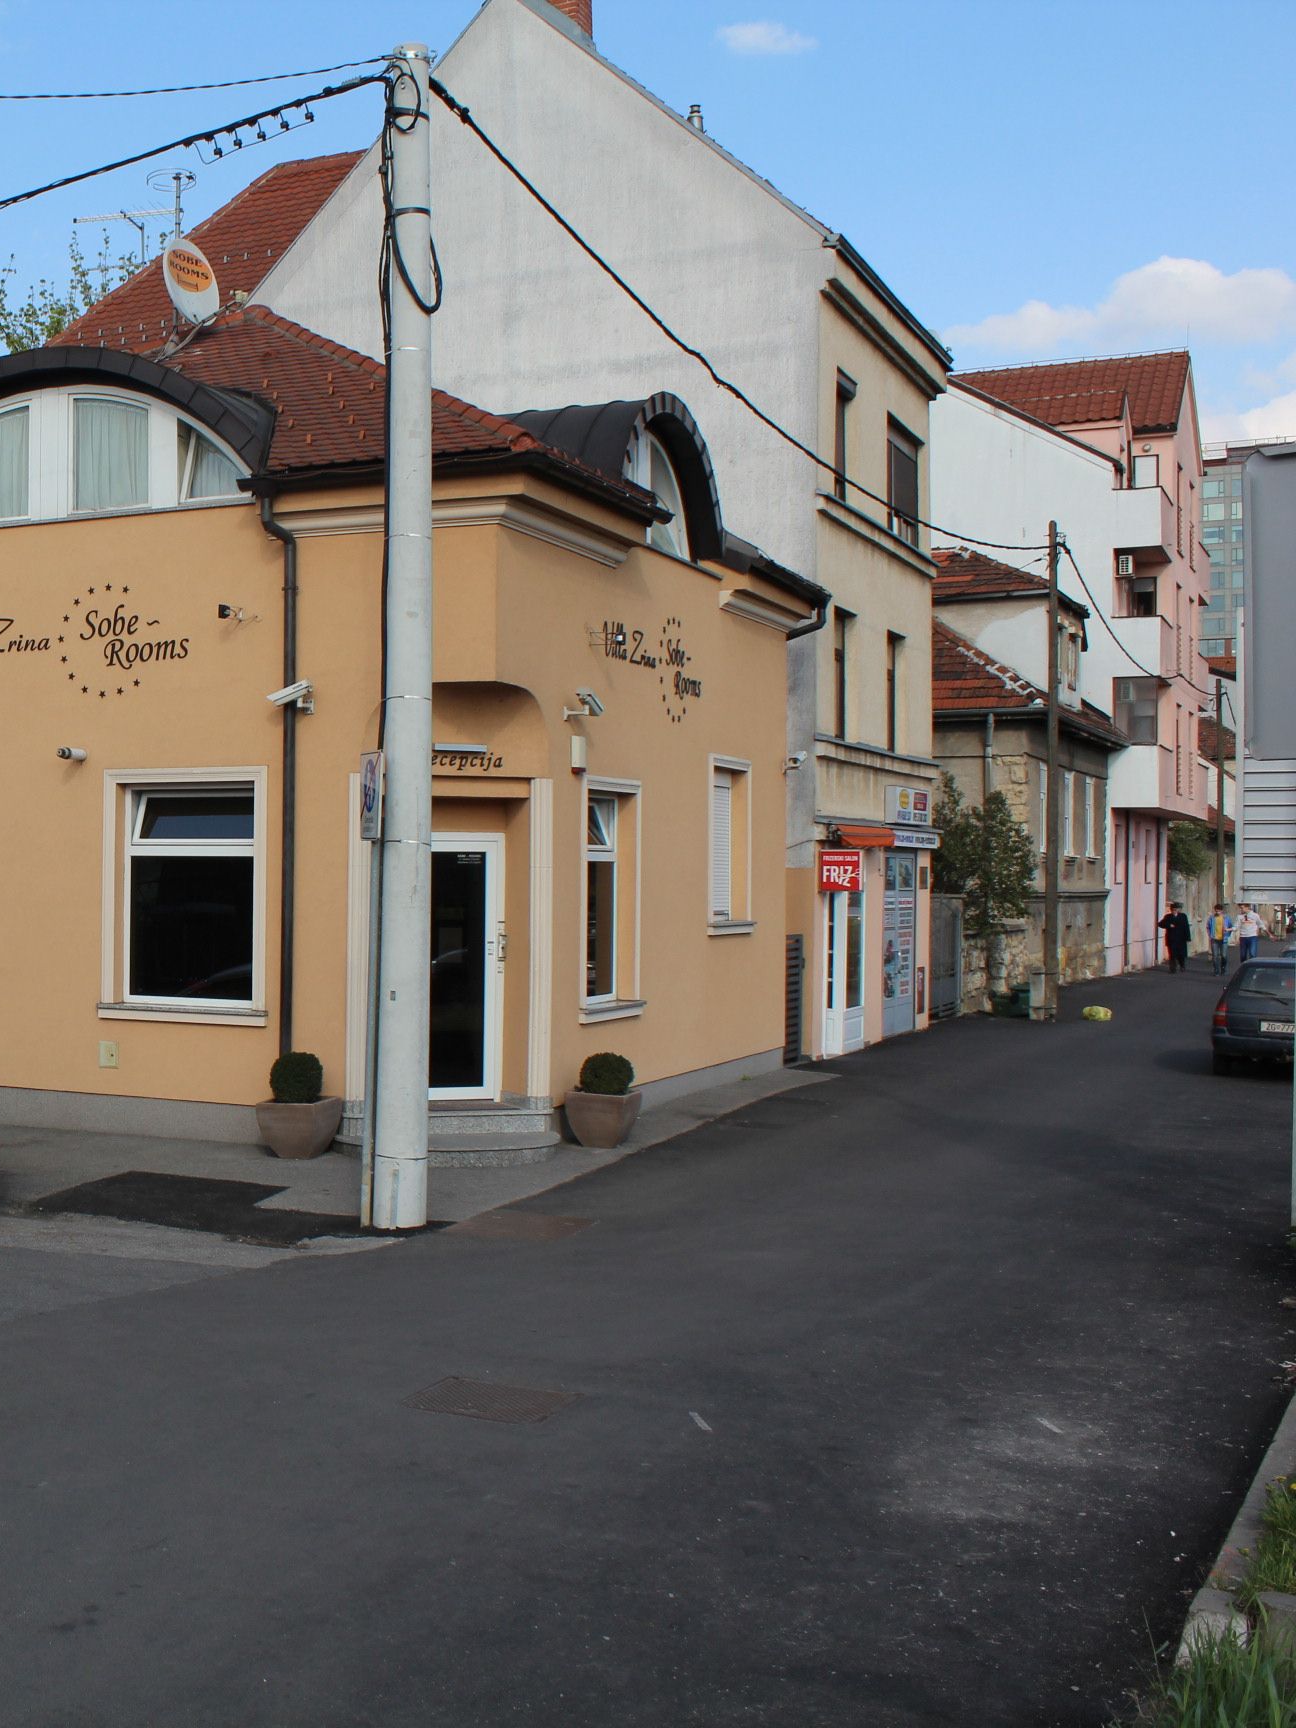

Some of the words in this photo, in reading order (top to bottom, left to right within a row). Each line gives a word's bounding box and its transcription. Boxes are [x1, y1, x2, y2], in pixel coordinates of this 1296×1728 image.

[169, 260, 209, 280] ROOMS
[79, 604, 139, 641] Sobe
[104, 637, 190, 670] Rooms
[630, 630, 656, 669] Zrina
[673, 670, 702, 700] Rooms
[431, 751, 504, 772] ecepcija
[822, 865, 853, 887] FRIZ
